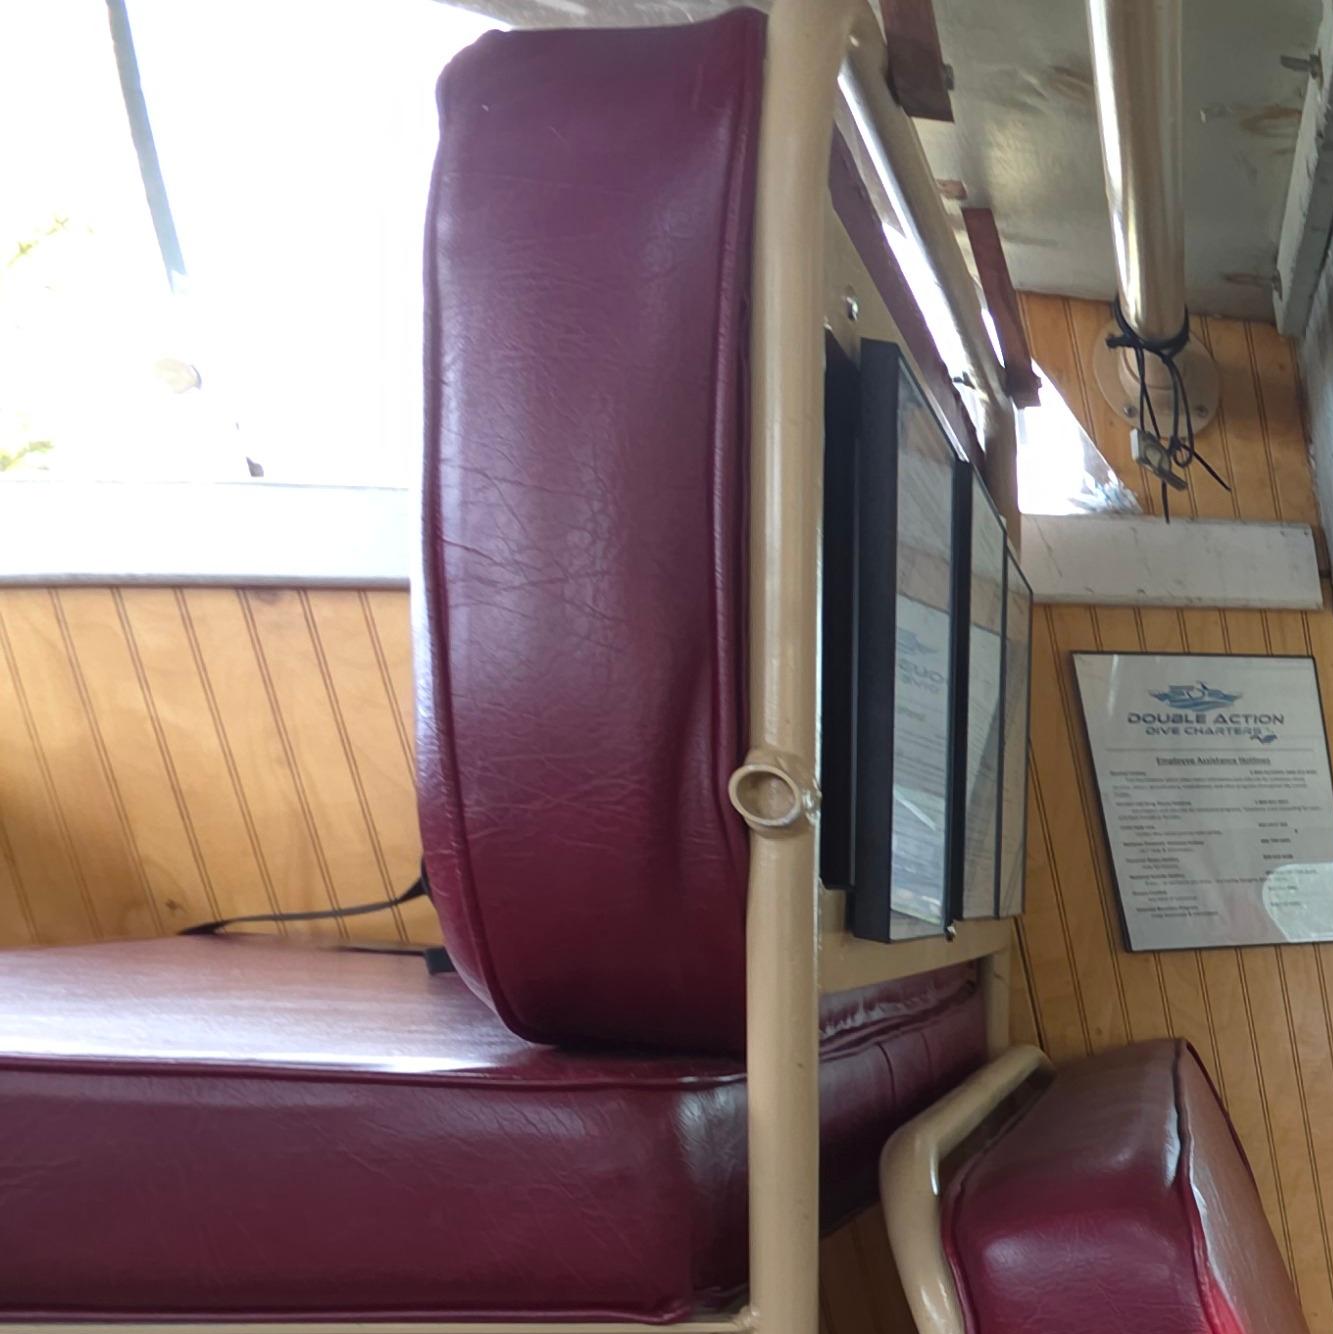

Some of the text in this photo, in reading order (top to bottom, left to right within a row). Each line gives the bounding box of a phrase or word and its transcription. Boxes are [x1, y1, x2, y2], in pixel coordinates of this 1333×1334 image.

[1128, 712, 1284, 725] DOUBLE ACTION
[1146, 727, 1262, 736] DIVE CHARTERS
